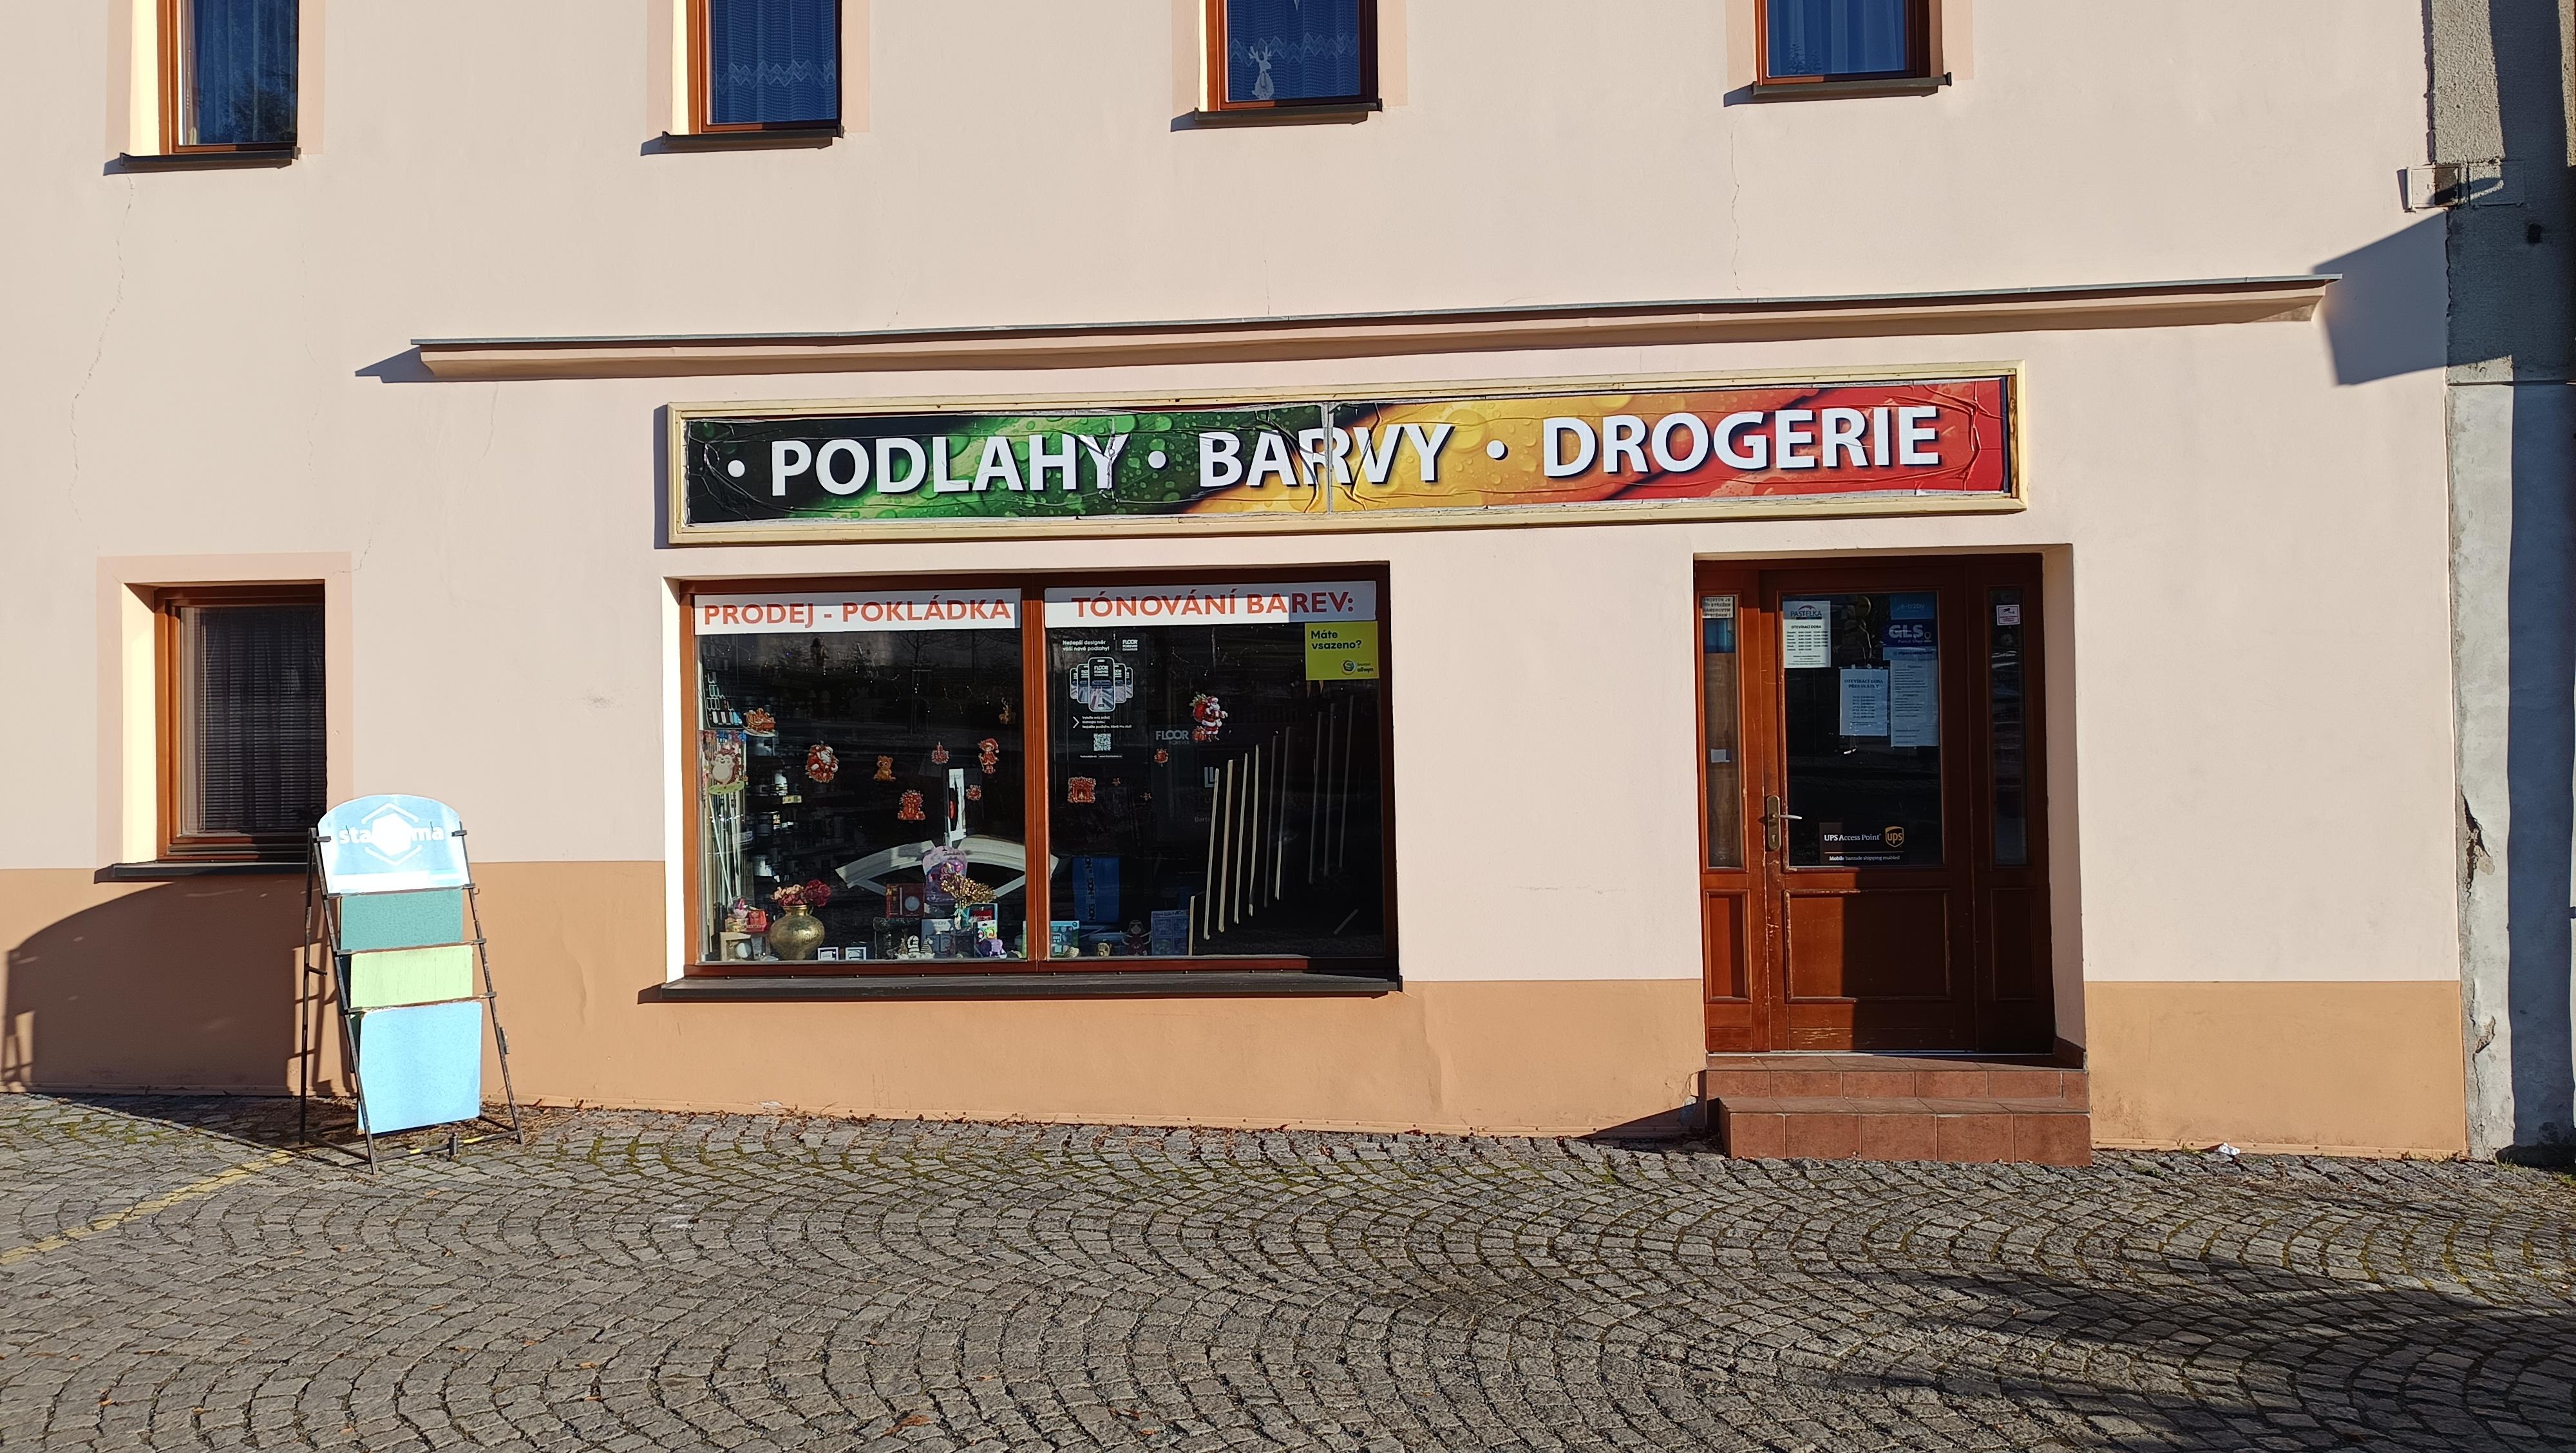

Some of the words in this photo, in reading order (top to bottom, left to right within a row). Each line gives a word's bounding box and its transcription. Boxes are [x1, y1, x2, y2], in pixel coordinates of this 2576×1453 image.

[772, 430, 1130, 497] PODLAHY
[1198, 423, 1455, 489] BARVY
[1543, 405, 1940, 478] DROGERIE
[1071, 588, 1236, 618] TÓNOVÁNÍ
[1246, 591, 1354, 614] BAREV:
[704, 602, 814, 628] PRODEJ
[842, 594, 1011, 622] POKLÁDKA
[1311, 629, 1338, 639] Máte
[1889, 624, 1924, 638] GLS
[1311, 640, 1362, 650] vsazeno?
[1155, 730, 1189, 740] FLOOR
[1887, 833, 1902, 844] ups
